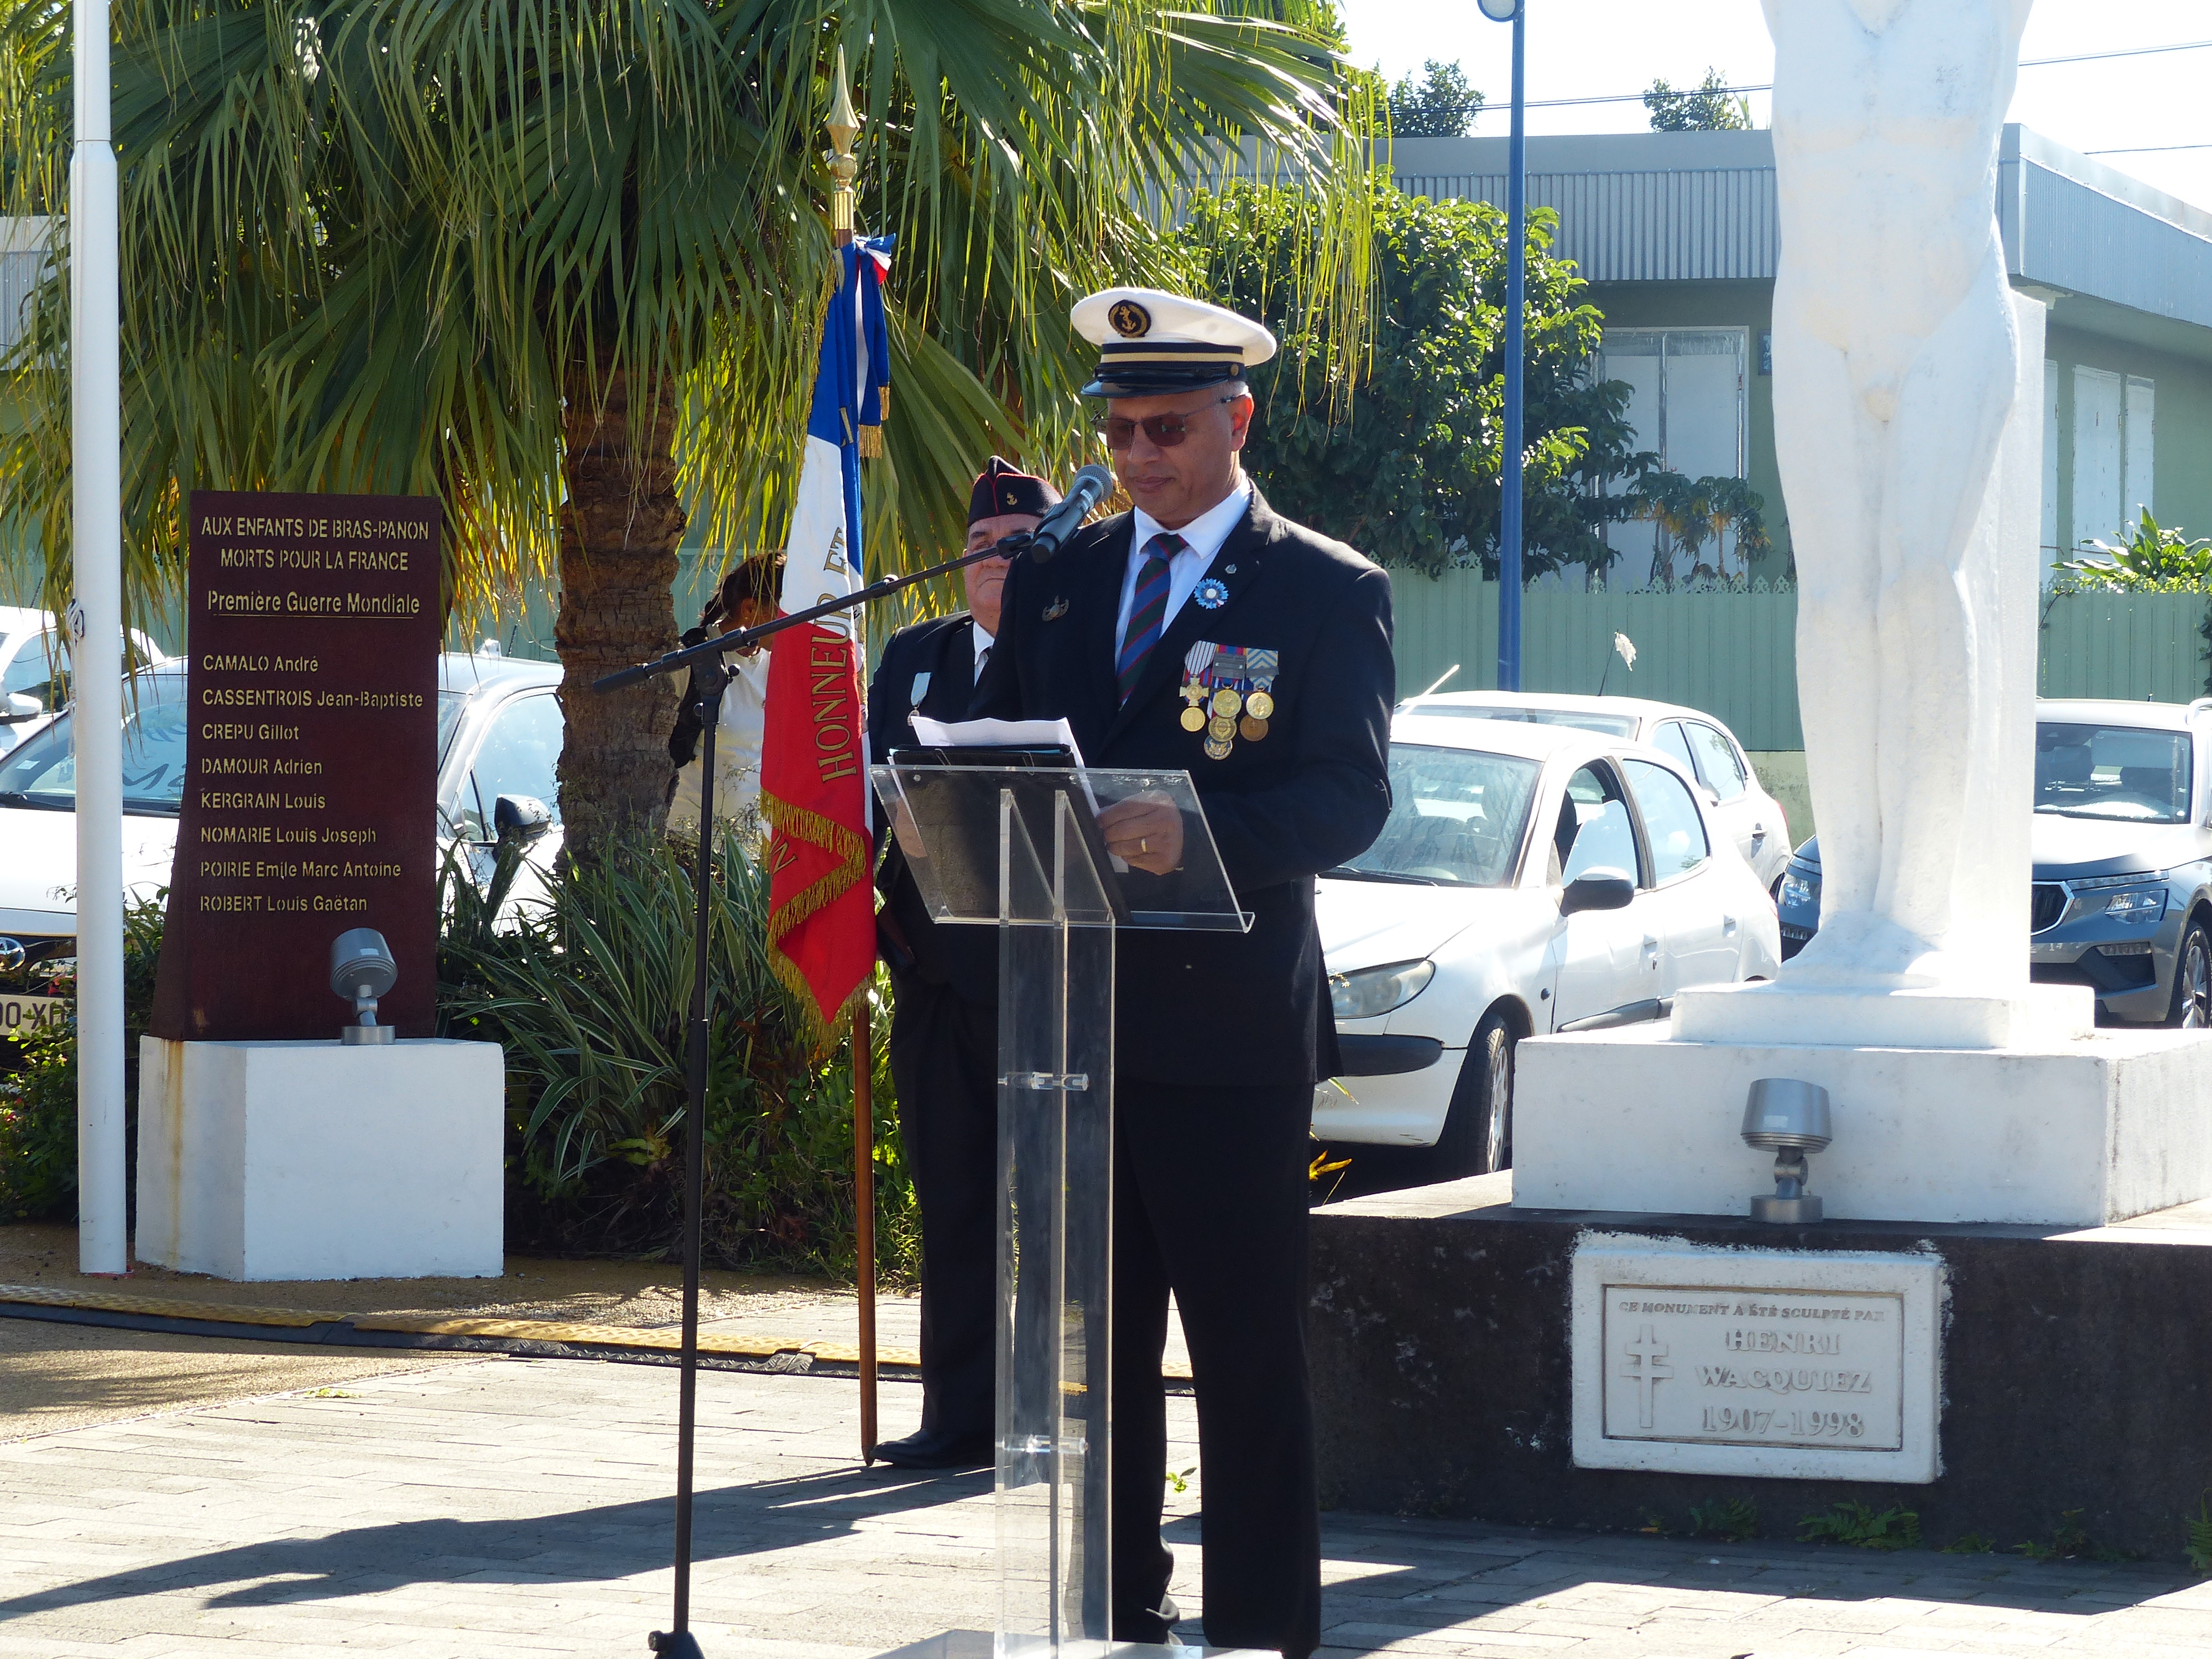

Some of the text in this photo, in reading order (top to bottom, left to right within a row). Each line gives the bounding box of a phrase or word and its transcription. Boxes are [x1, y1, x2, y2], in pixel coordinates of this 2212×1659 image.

[201, 517, 429, 540] AUX ENFANTS DE BRAS-PANON
[221, 548, 408, 571] MORTS POUR LA FRANCE
[823, 526, 850, 576] ET
[208, 590, 420, 613] Première Guerre Mondiale
[203, 655, 319, 672] CAMALO André
[202, 689, 423, 709] CASSENTROIS Jean-Baptiste
[202, 723, 299, 740] CREPU Gillot
[202, 758, 322, 774] DAMOUR Adrien
[201, 792, 326, 808] KERGRAIN Louis
[201, 827, 376, 846] NOMARIE Louis Joseph
[201, 861, 401, 877] POIRIE Emile Marc Antoine
[200, 895, 367, 911] ROBERT Louis Gaëtan
[1619, 1301, 1638, 1312] CE
[1641, 1302, 1730, 1316] MONUMENT
[1725, 1328, 1841, 1355] HENRI
[1695, 1365, 1872, 1395] WACQUIEZ
[1702, 1405, 1865, 1438] 1907-1998
